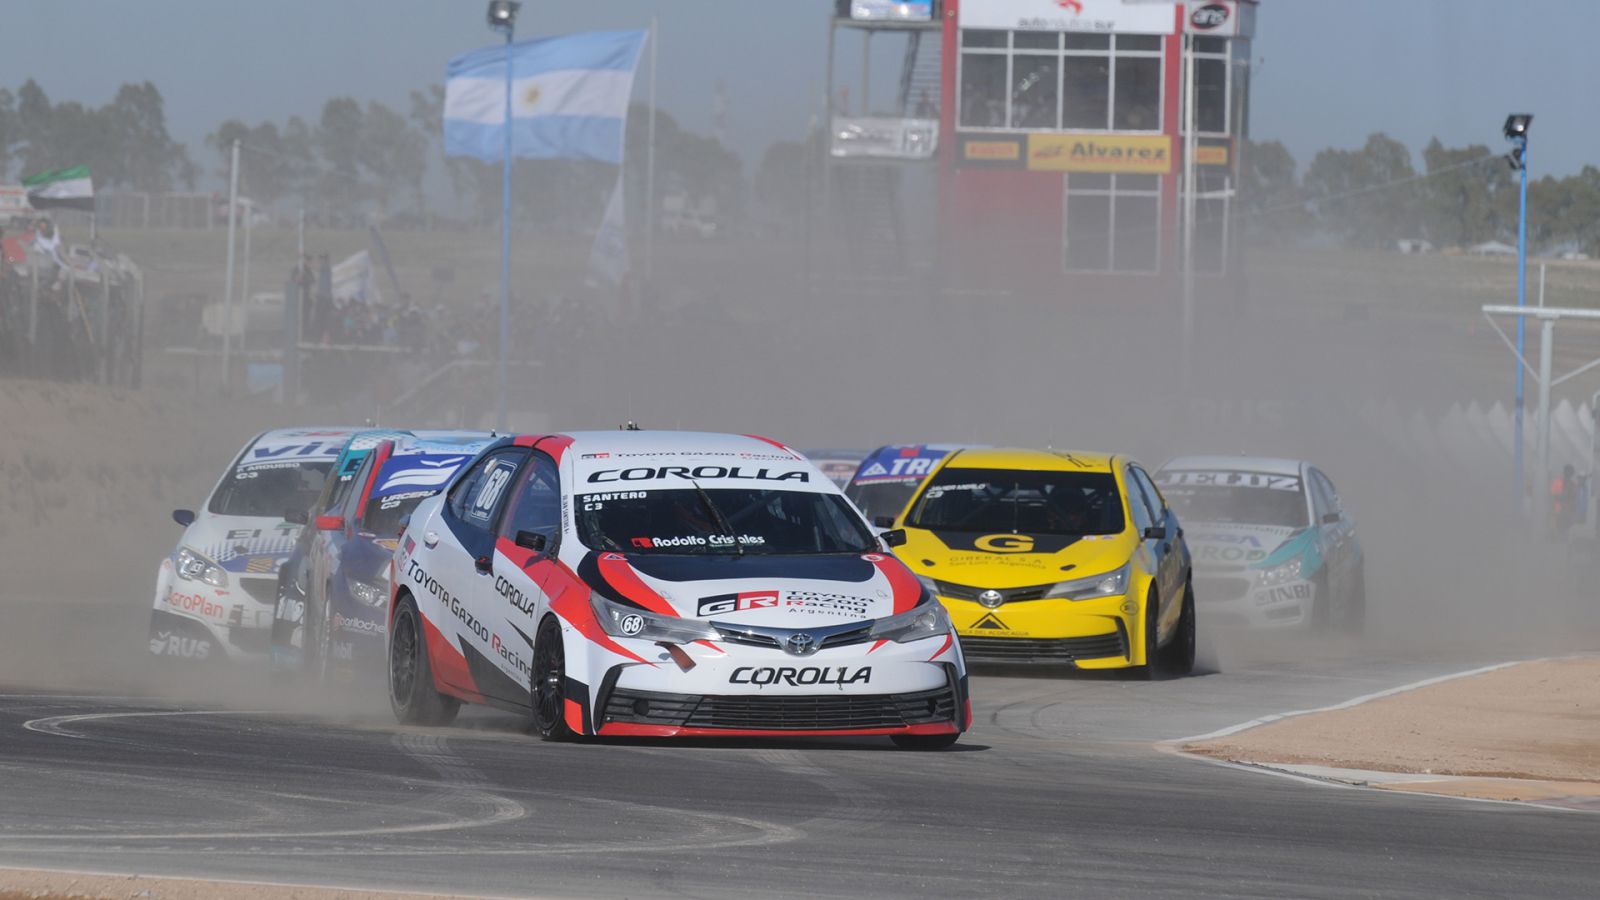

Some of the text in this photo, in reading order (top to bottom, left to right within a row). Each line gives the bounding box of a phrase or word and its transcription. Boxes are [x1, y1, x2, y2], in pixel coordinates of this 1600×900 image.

[1071, 142, 1166, 157] Alvarez
[236, 472, 258, 480] C3
[587, 466, 809, 483] COROLLA
[477, 468, 510, 510] 68
[381, 500, 401, 509] C3
[583, 491, 647, 503] SANTERO
[652, 534, 765, 548] Rodolfo Crisales
[974, 533, 1034, 552] G
[407, 559, 449, 608] TOYOTA
[451, 597, 488, 642] GAZOO
[495, 575, 535, 618] COROLLA
[786, 591, 874, 602] TOYOTA
[786, 596, 868, 606] GAZOO
[698, 594, 778, 616] GR
[786, 601, 866, 614] Racing
[788, 608, 867, 618] Argentina
[623, 615, 642, 634] 68
[729, 666, 872, 685] COROLLA
